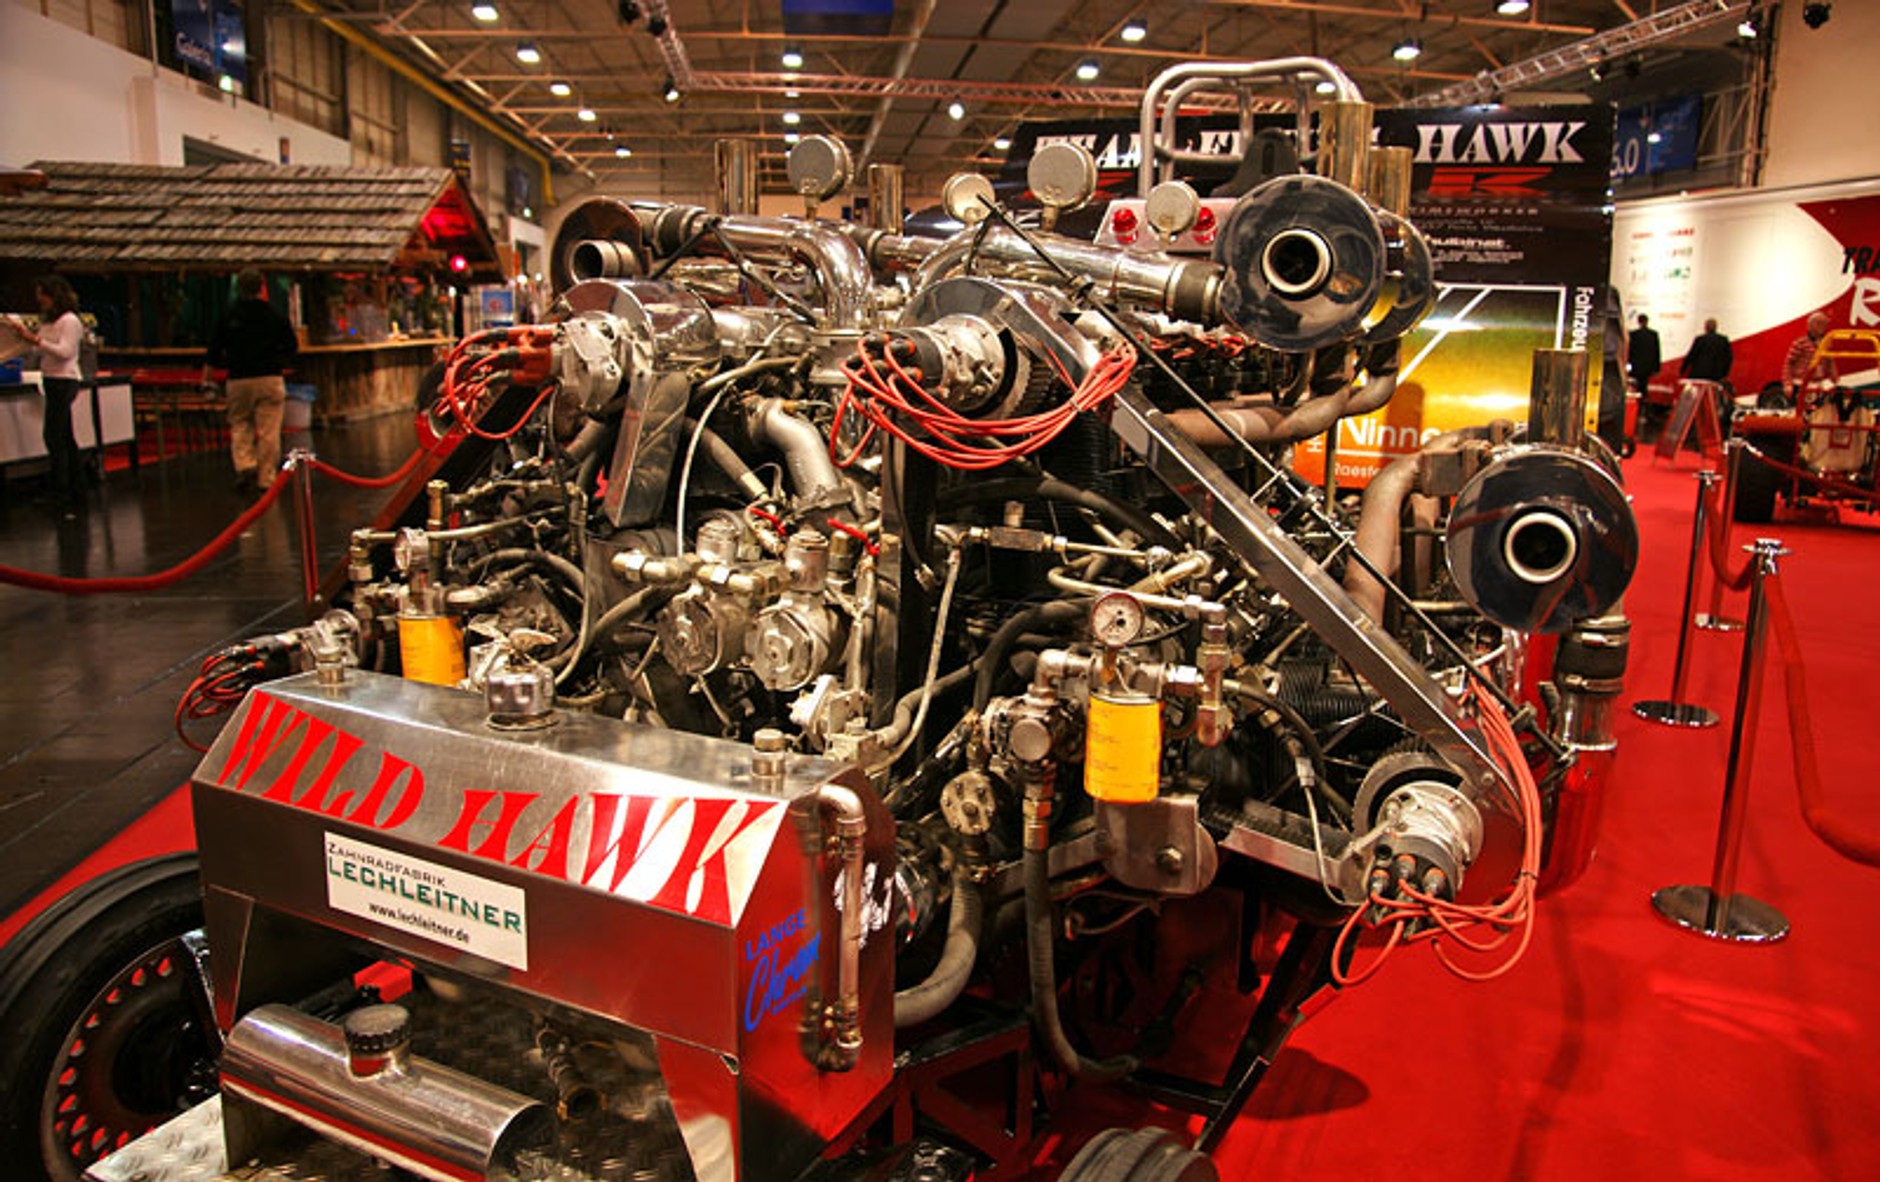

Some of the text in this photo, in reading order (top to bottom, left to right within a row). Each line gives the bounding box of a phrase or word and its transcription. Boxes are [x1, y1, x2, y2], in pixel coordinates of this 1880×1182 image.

[1414, 121, 1587, 163] HAWK
[217, 690, 424, 829] WILD
[438, 790, 781, 928] HAWK
[328, 855, 521, 934] LECHLEITNER
[369, 903, 470, 944] www.lechleitner.de
[746, 907, 807, 961] LANGE
